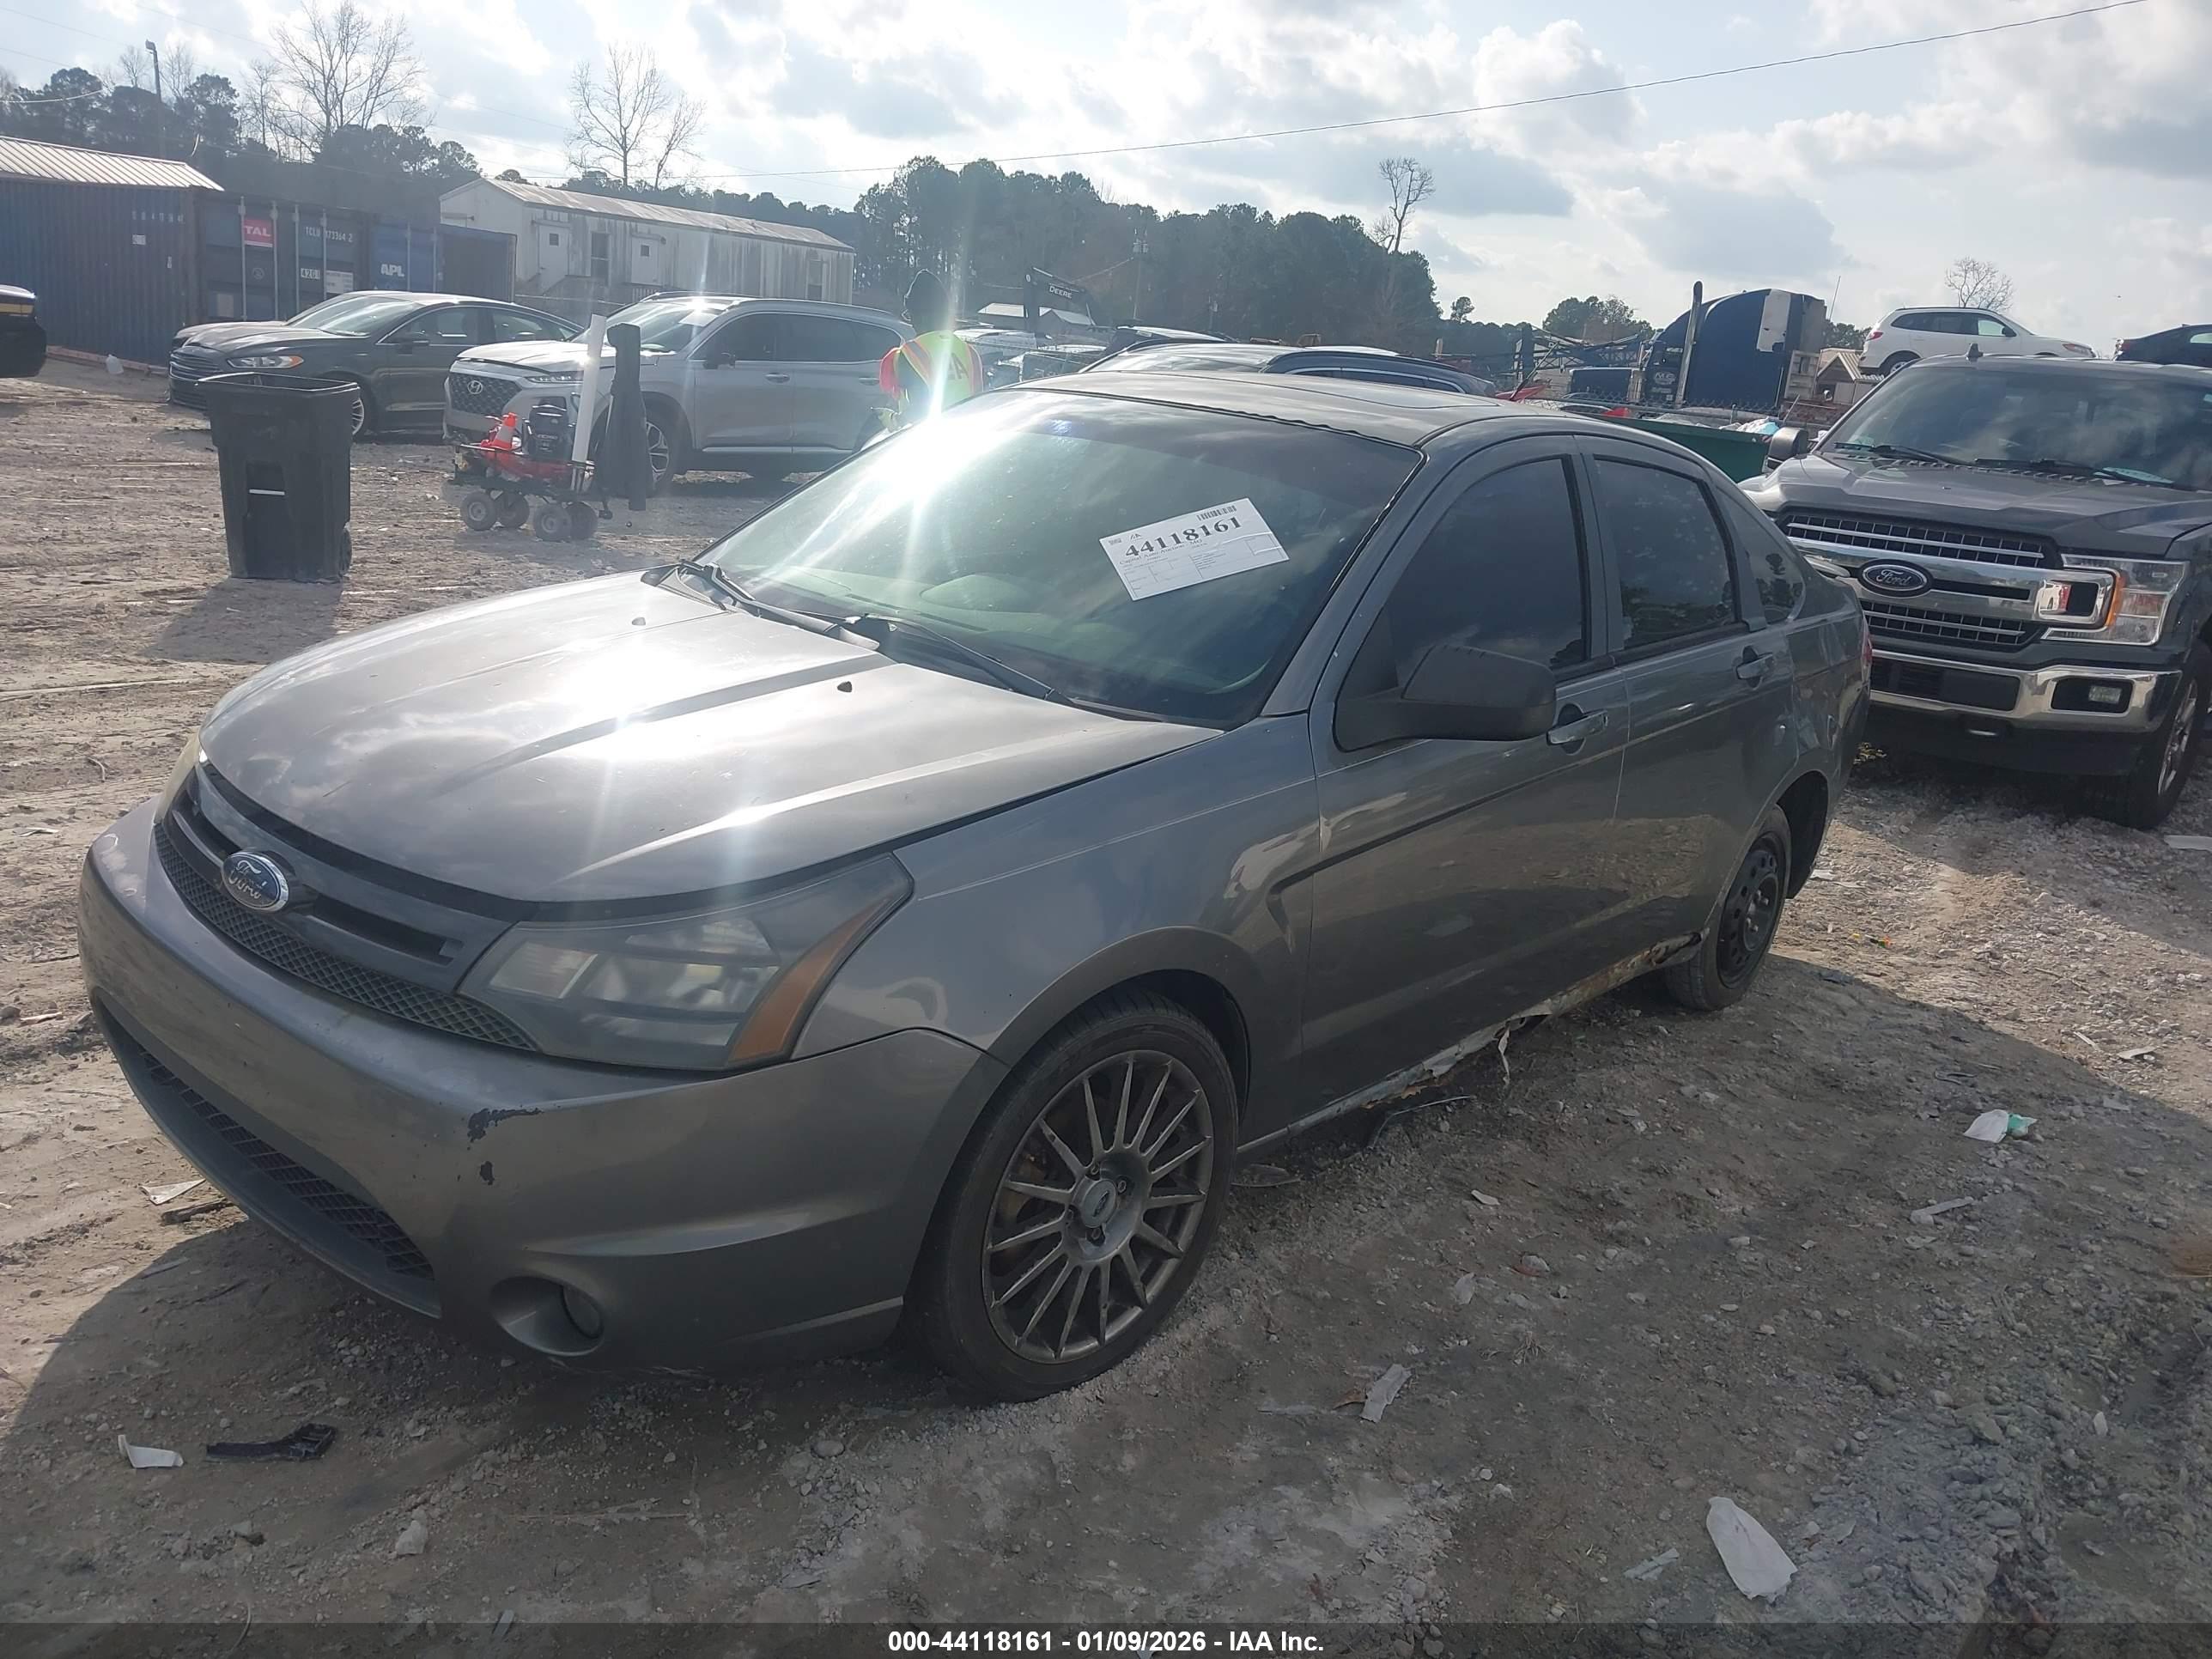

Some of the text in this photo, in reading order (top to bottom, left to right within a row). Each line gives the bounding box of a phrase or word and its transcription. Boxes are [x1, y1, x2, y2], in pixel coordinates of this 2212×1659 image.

[245, 226, 271, 237] TAL
[380, 264, 405, 276] APL
[1049, 285, 1073, 299] DEERE
[1125, 517, 1242, 556] 44118161
[1875, 568, 1912, 585] Ford
[228, 860, 268, 900] Ford
